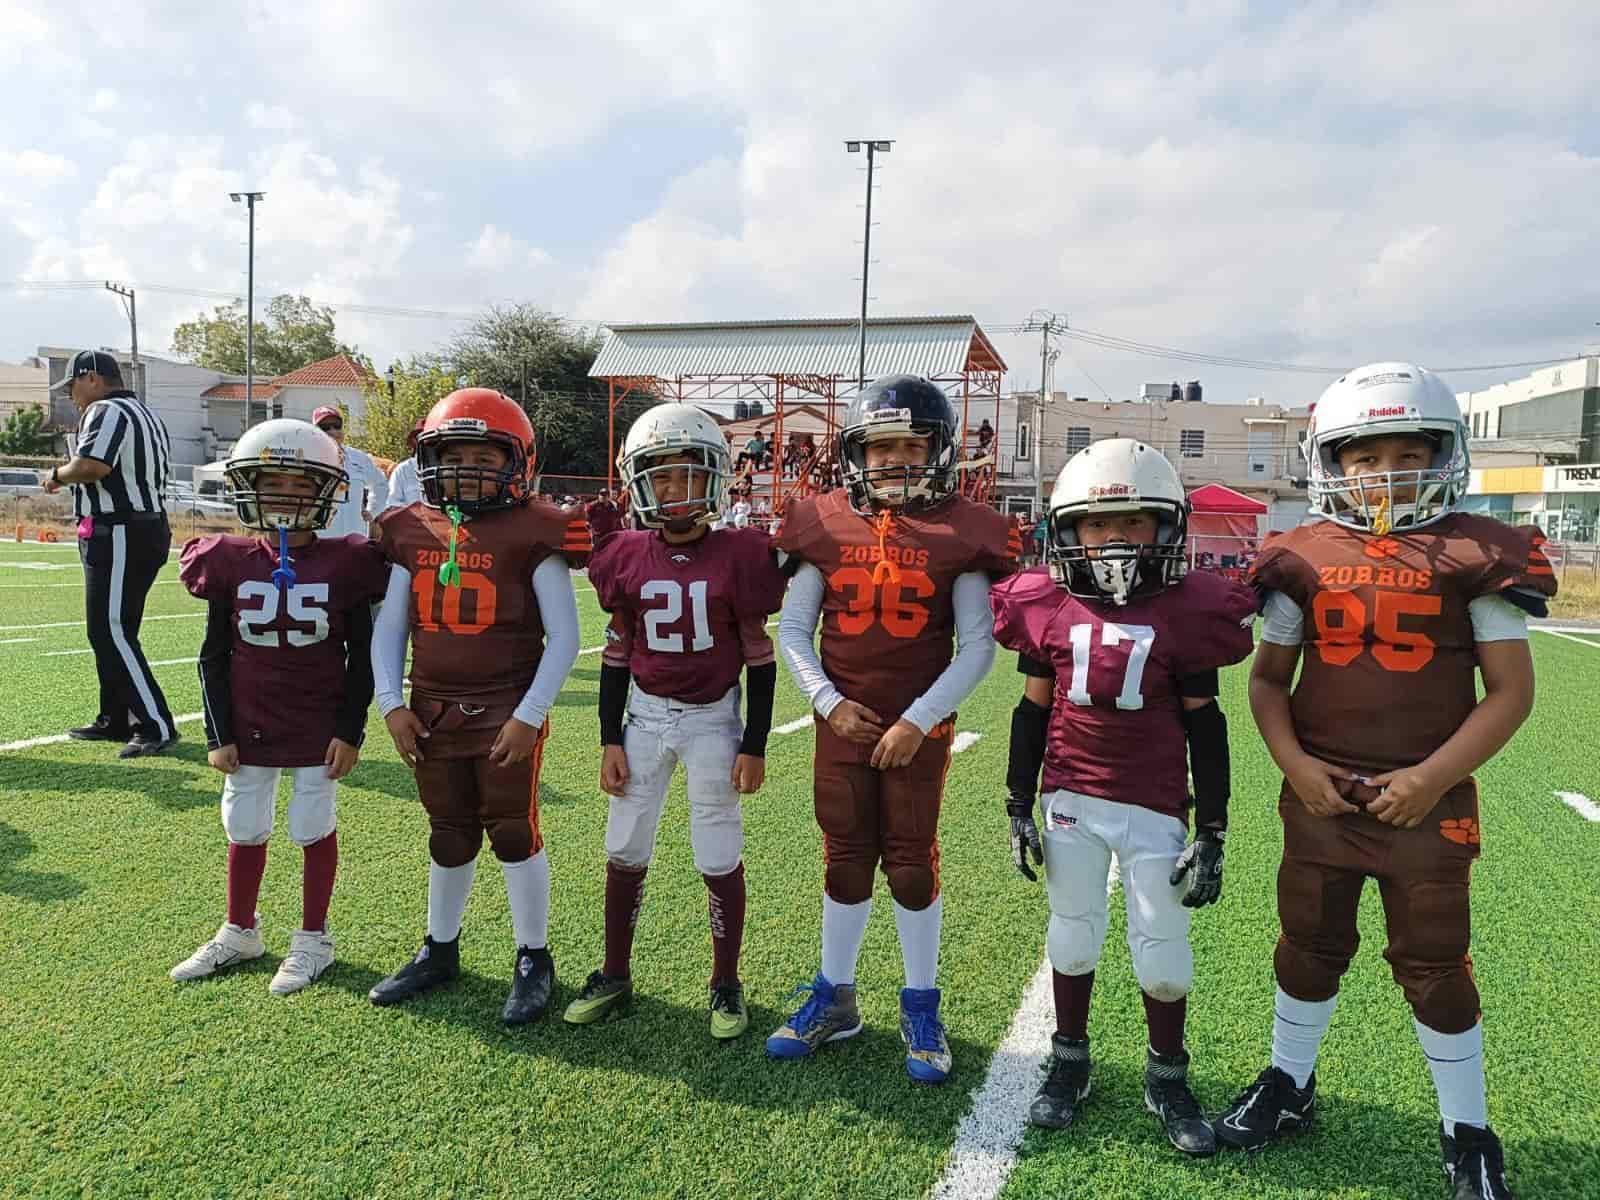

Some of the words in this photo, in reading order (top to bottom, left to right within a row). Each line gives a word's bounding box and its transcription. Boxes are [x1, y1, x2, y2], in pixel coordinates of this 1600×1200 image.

[237, 580, 329, 648] 25
[413, 568, 497, 635] 10
[640, 580, 714, 653] 21
[829, 567, 936, 638] 36
[1312, 590, 1442, 673] 85
[1067, 622, 1156, 711] 17
